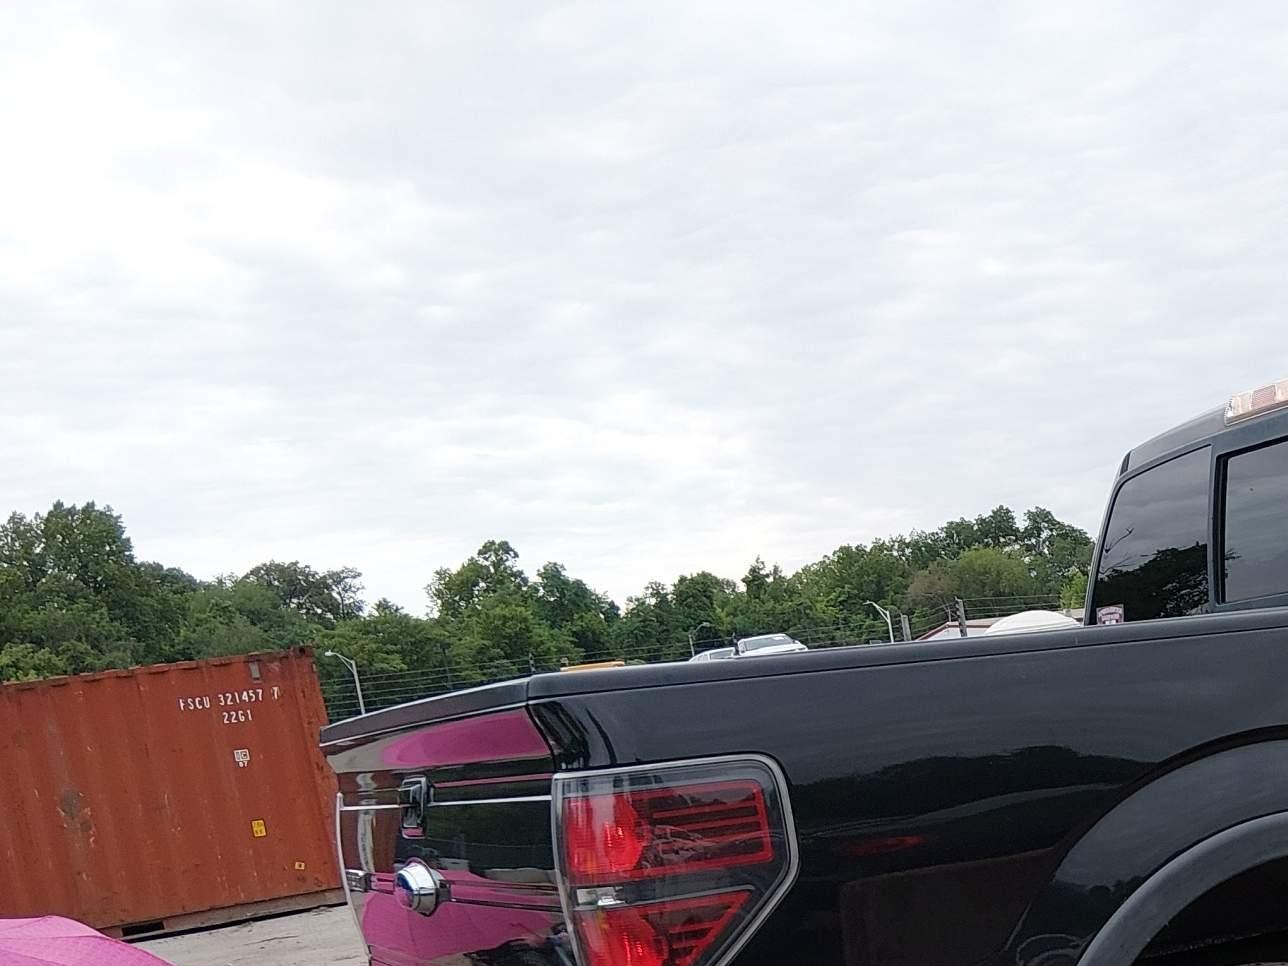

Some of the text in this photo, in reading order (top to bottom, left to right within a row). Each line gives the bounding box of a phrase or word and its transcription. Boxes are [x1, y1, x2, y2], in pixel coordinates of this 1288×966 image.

[179, 686, 281, 711] FSCU 321457 7
[222, 710, 252, 723] 22G1
